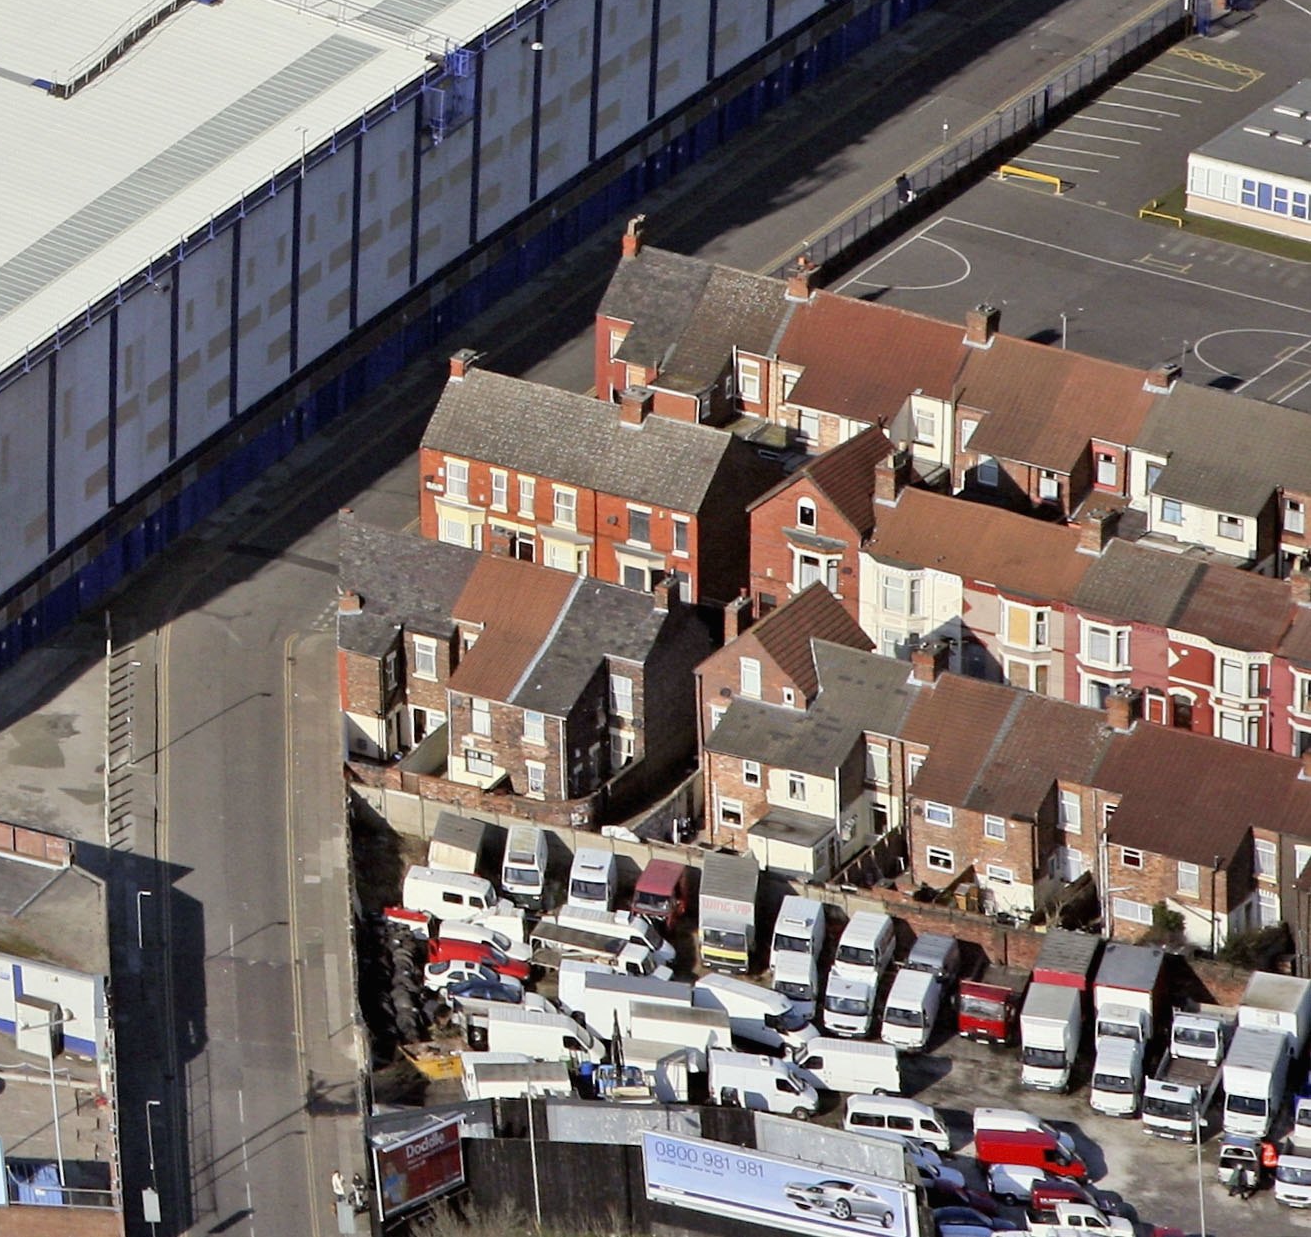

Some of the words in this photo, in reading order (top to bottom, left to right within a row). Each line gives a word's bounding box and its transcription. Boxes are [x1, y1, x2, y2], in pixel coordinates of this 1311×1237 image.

[654, 1141, 698, 1163] 0800
[702, 1152, 730, 1170] 981
[736, 1159, 764, 1178] 981
